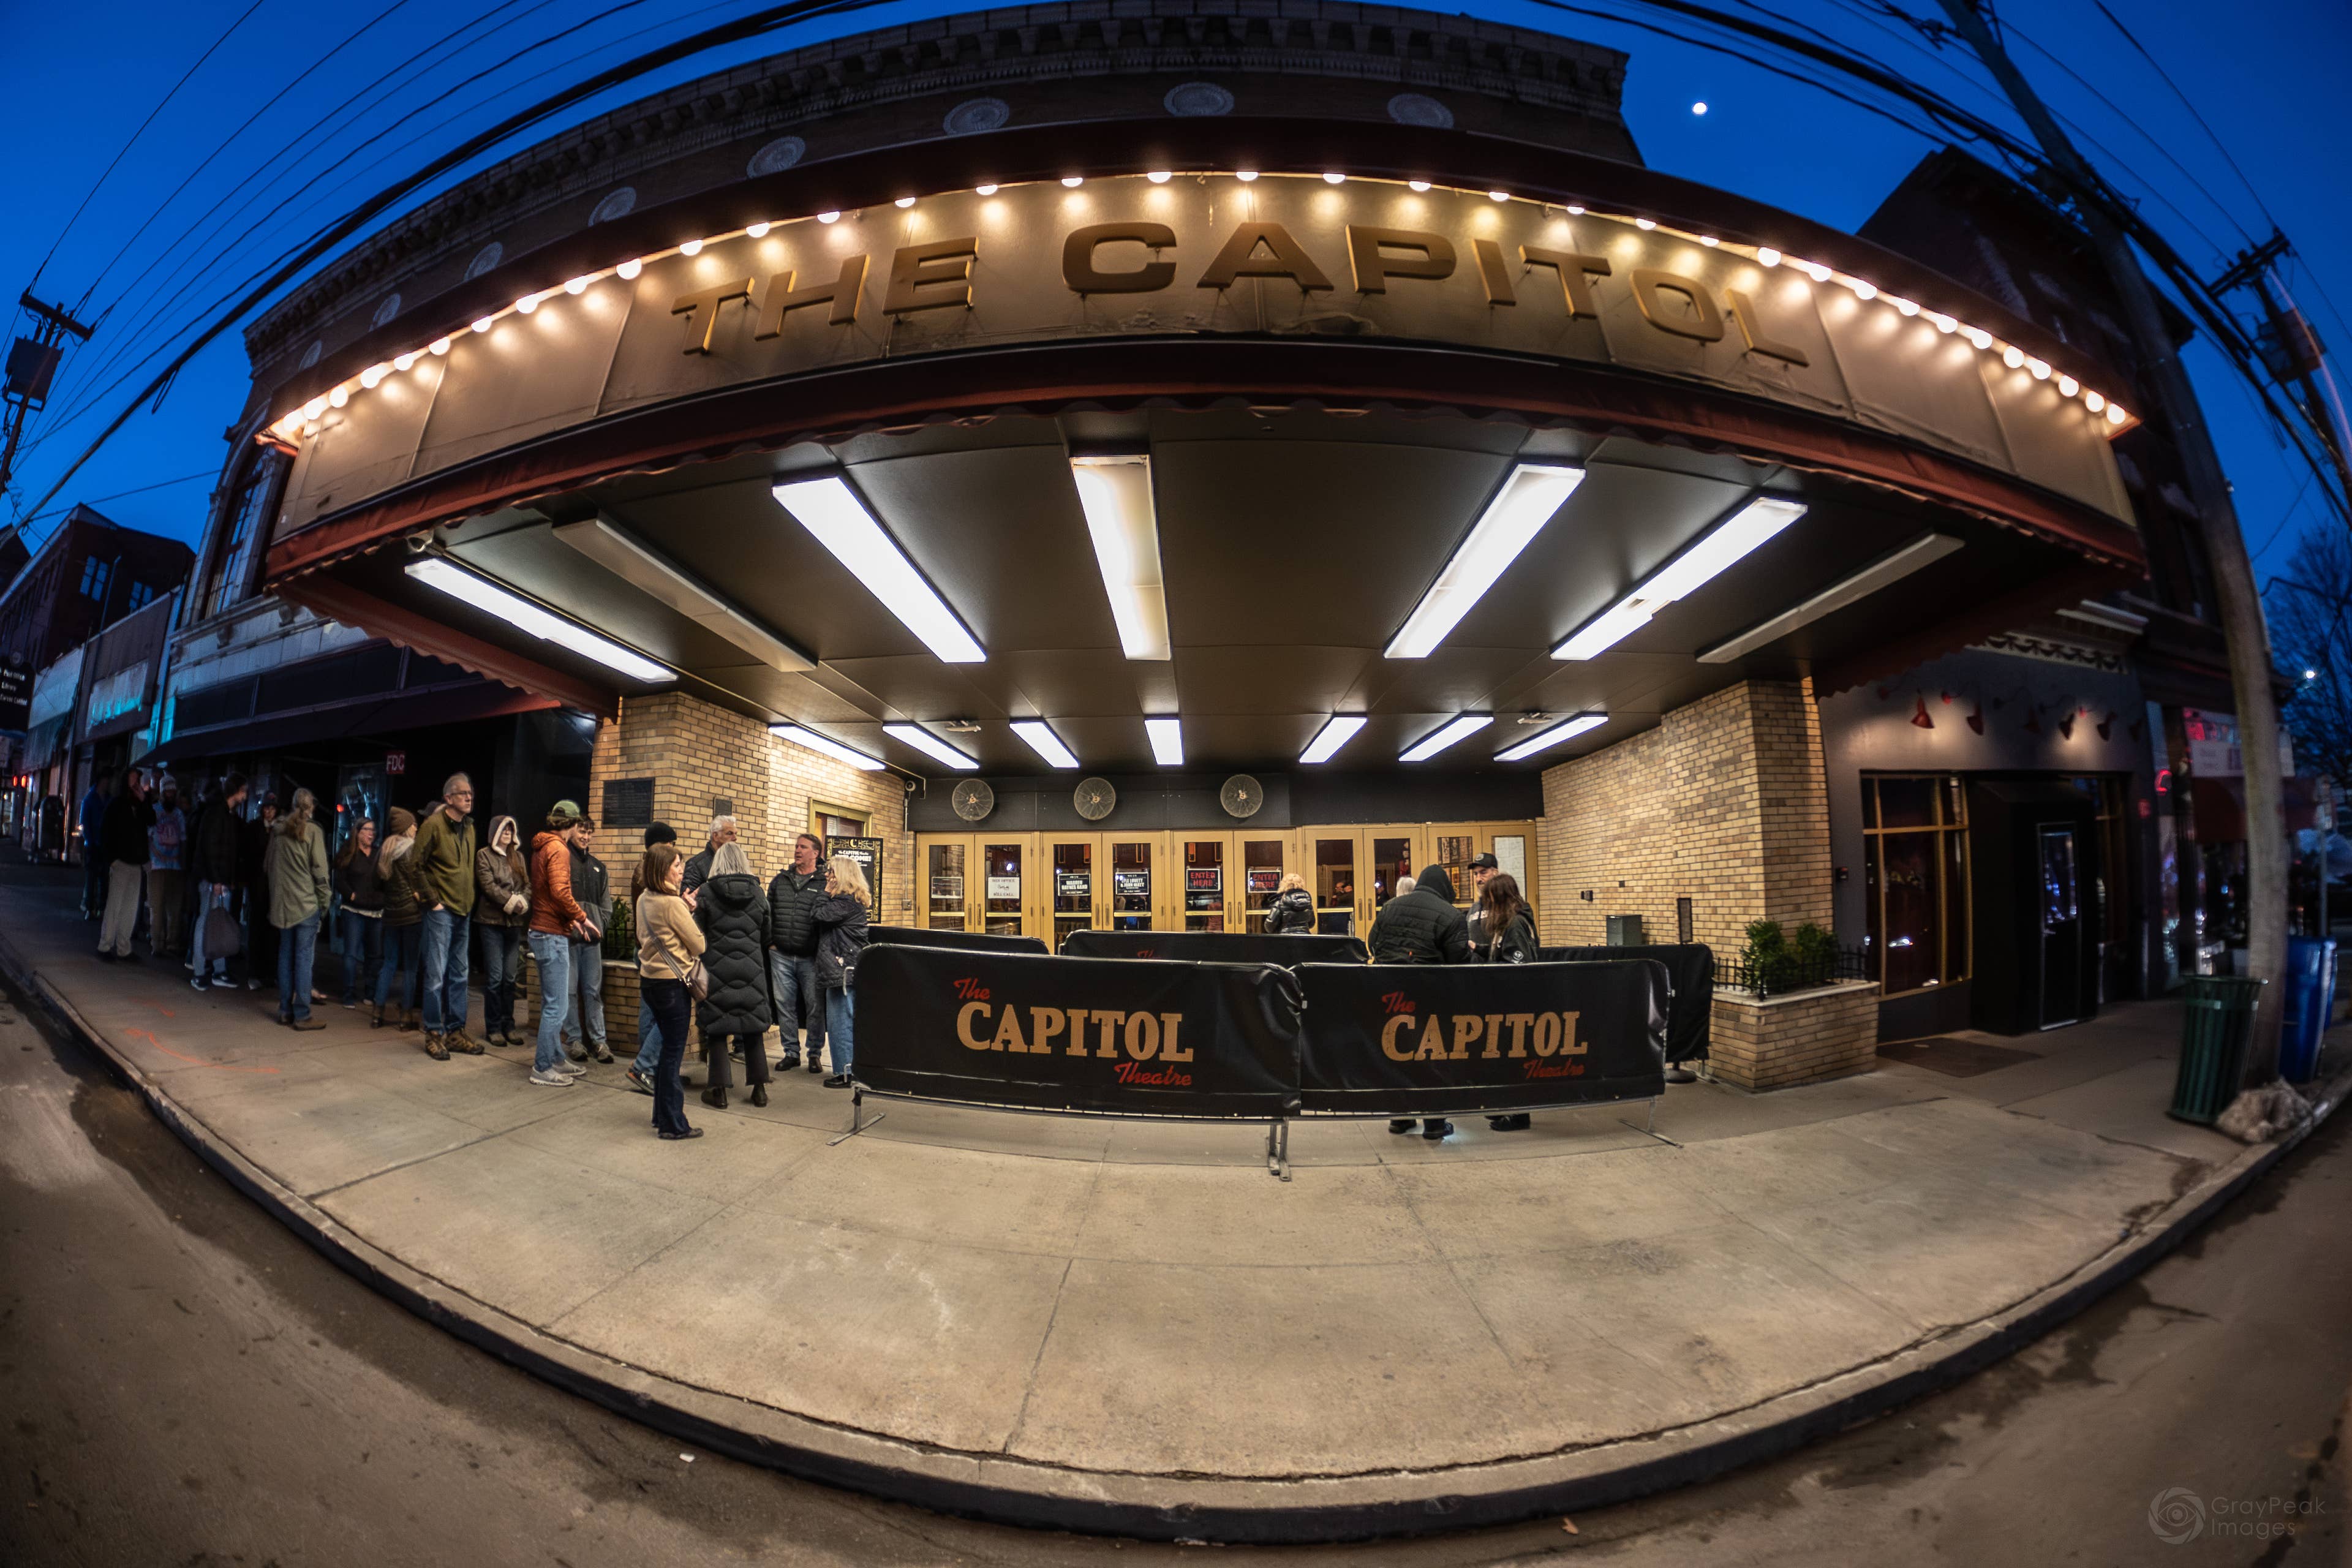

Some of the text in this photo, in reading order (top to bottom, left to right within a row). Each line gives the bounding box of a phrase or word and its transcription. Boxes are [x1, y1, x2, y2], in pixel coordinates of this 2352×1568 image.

[671, 221, 1810, 368] THE CAPITOL
[386, 754, 405, 771] FDC
[954, 978, 990, 1001] The
[1381, 992, 1416, 1014] The
[956, 1001, 1194, 1063] CAPITOL
[1381, 1011, 1588, 1061] CAPITOL
[1114, 1061, 1193, 1087] Theatre
[1523, 1058, 1585, 1079] Theatre
